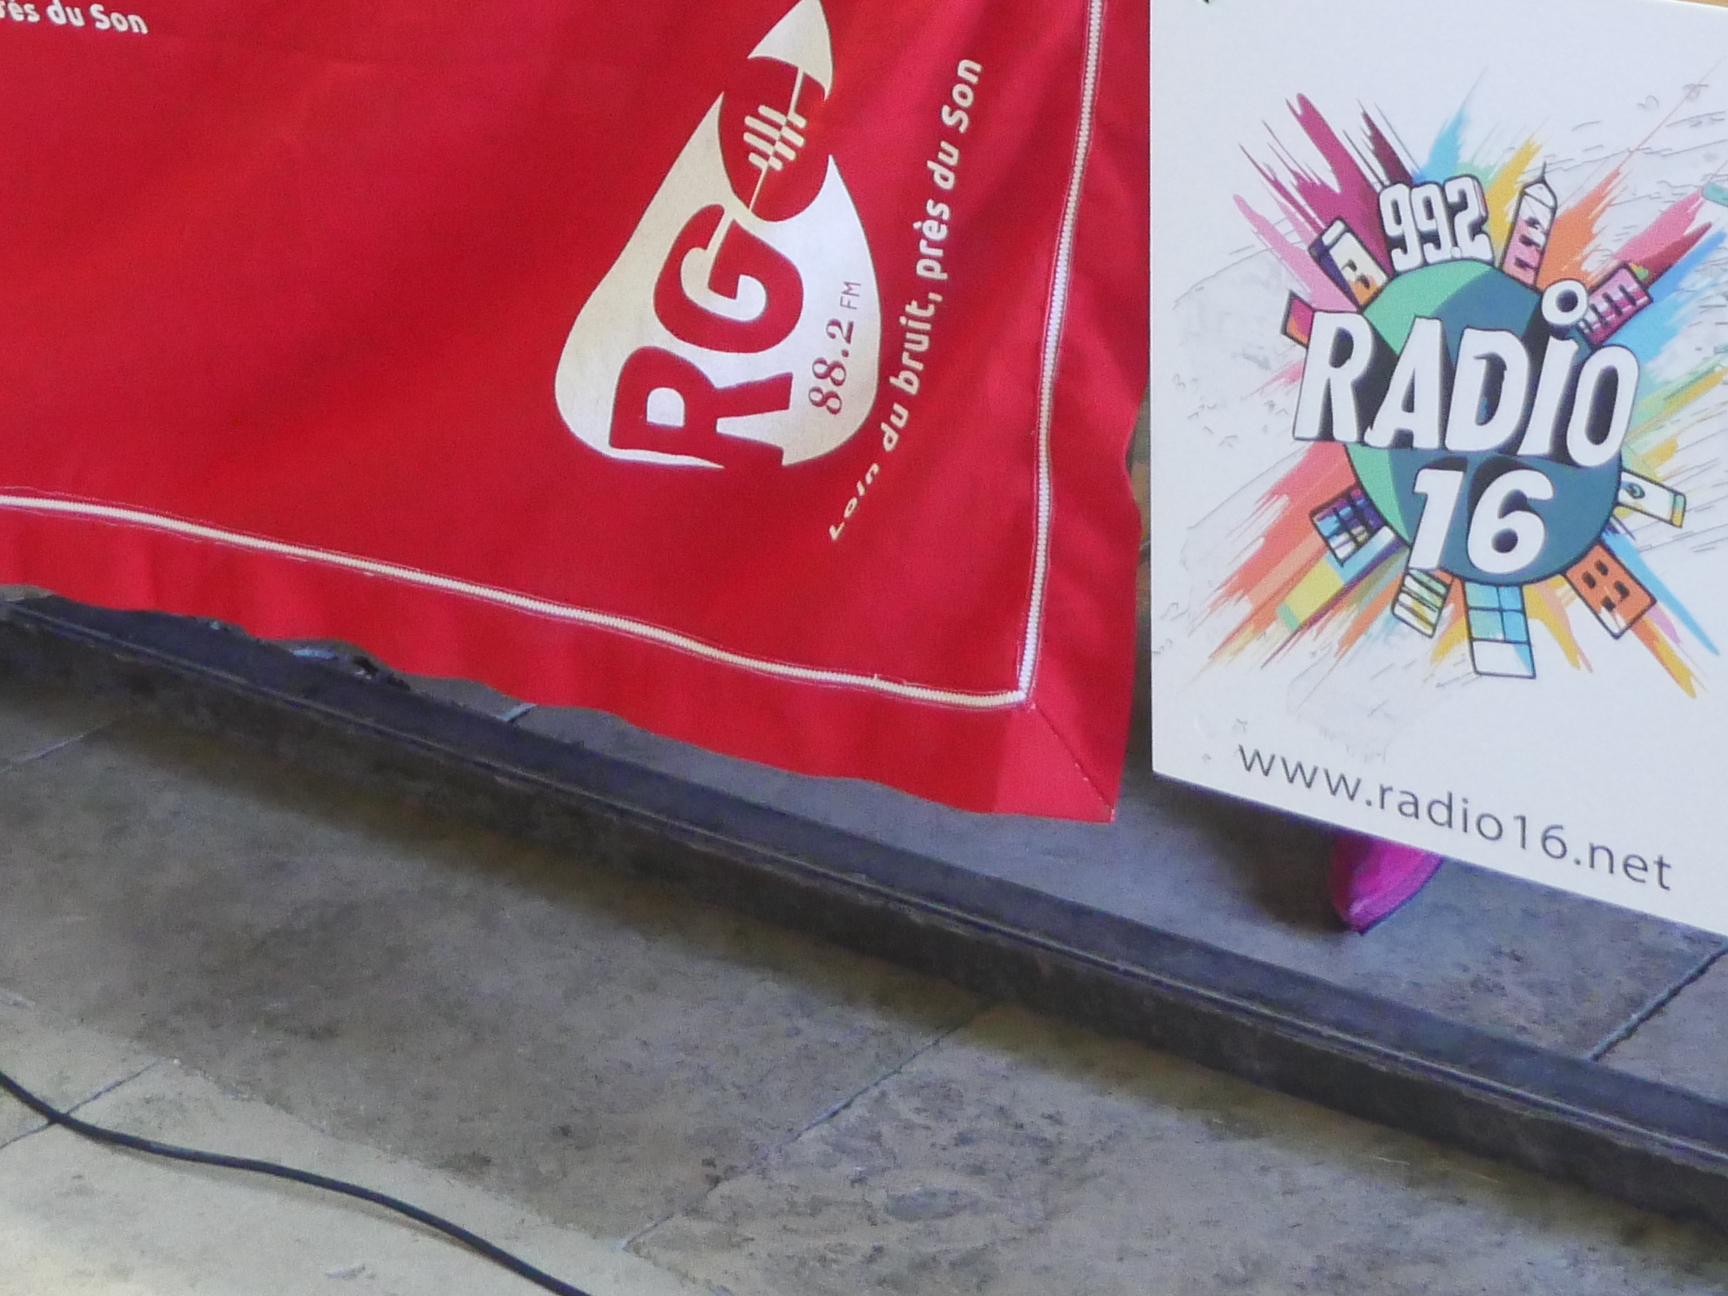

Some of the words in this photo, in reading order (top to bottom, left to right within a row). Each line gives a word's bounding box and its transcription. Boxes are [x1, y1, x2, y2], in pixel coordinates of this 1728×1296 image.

[88, 2, 149, 35] Son
[940, 57, 983, 134] Son
[926, 140, 962, 193] du
[912, 196, 953, 282] près
[1378, 173, 1495, 274] 99.2
[807, 317, 857, 416] 88.2
[838, 279, 862, 311] FM
[888, 289, 945, 398] bruit,
[881, 402, 911, 454] du
[828, 462, 881, 542] Loin
[1408, 468, 1556, 575] 16
[1237, 743, 1673, 892] www.radio16.net
